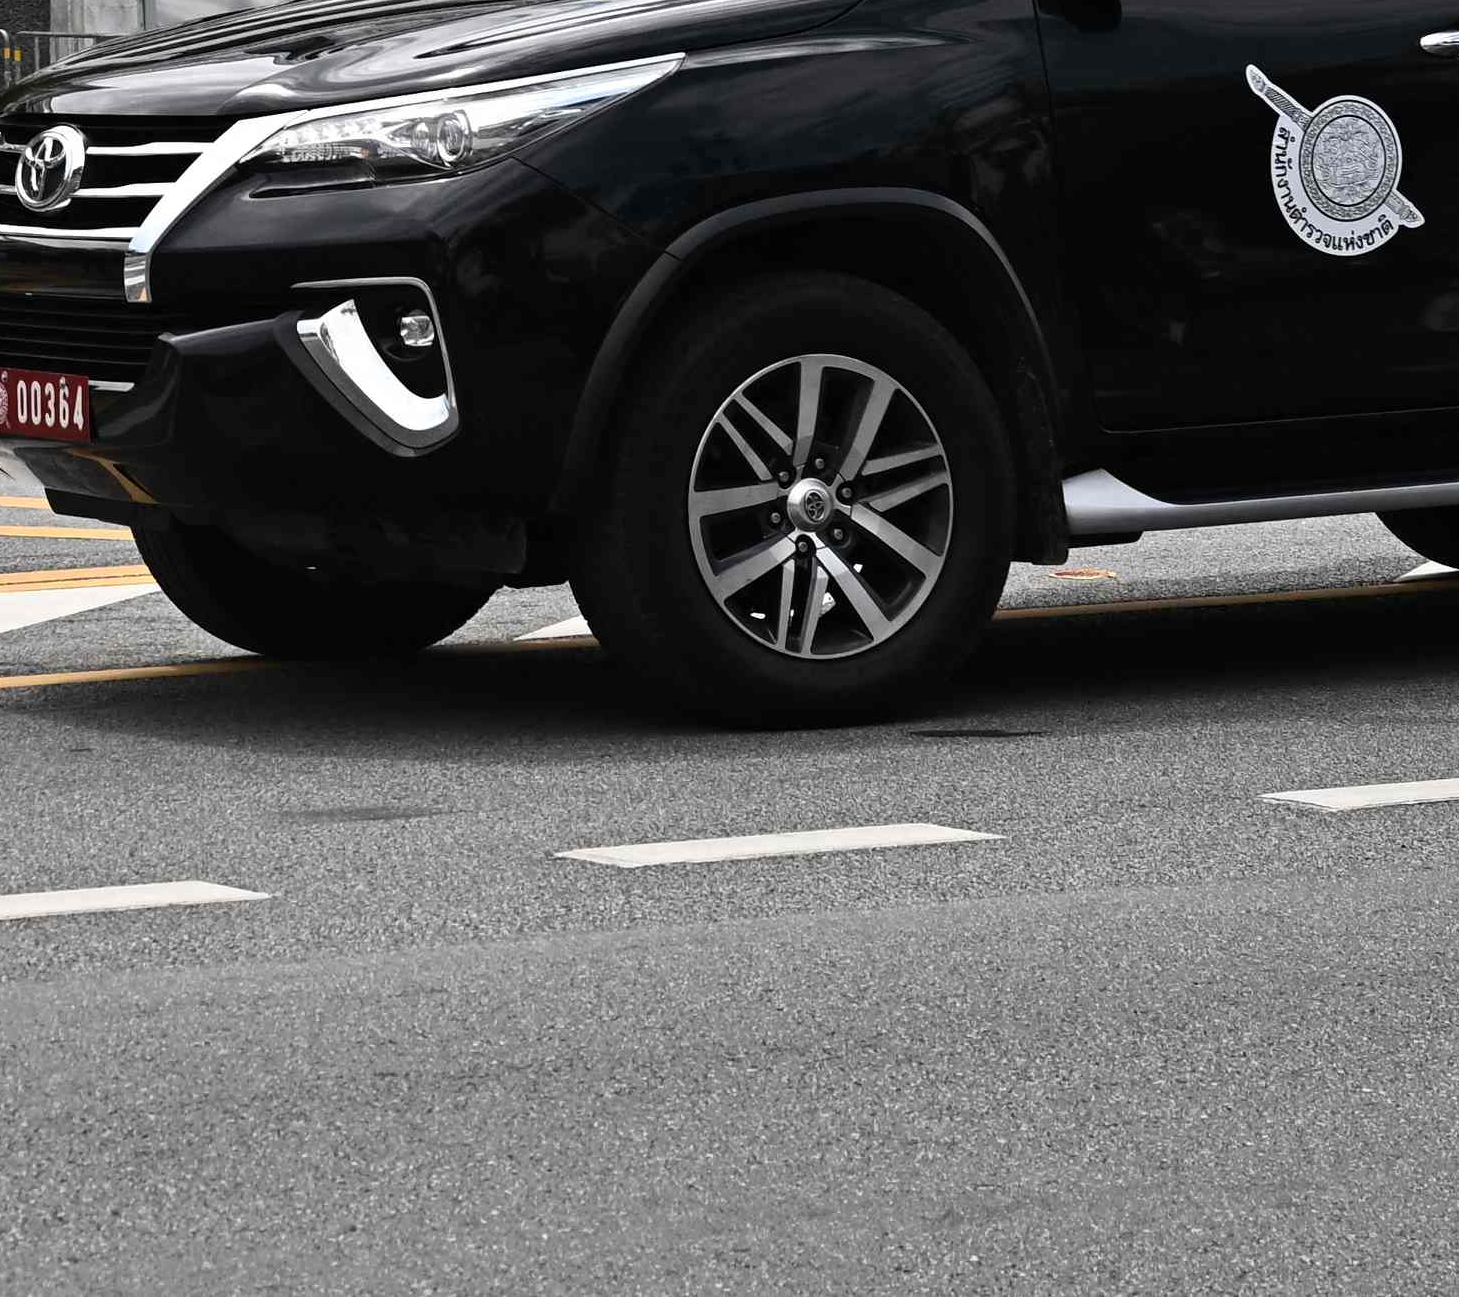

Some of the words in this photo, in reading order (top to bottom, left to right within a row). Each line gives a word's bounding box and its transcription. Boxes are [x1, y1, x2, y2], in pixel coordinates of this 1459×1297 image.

[1274, 126, 1395, 252] สำนักงานตำรวจแห่งชาติ
[16, 379, 85, 431] 00364
